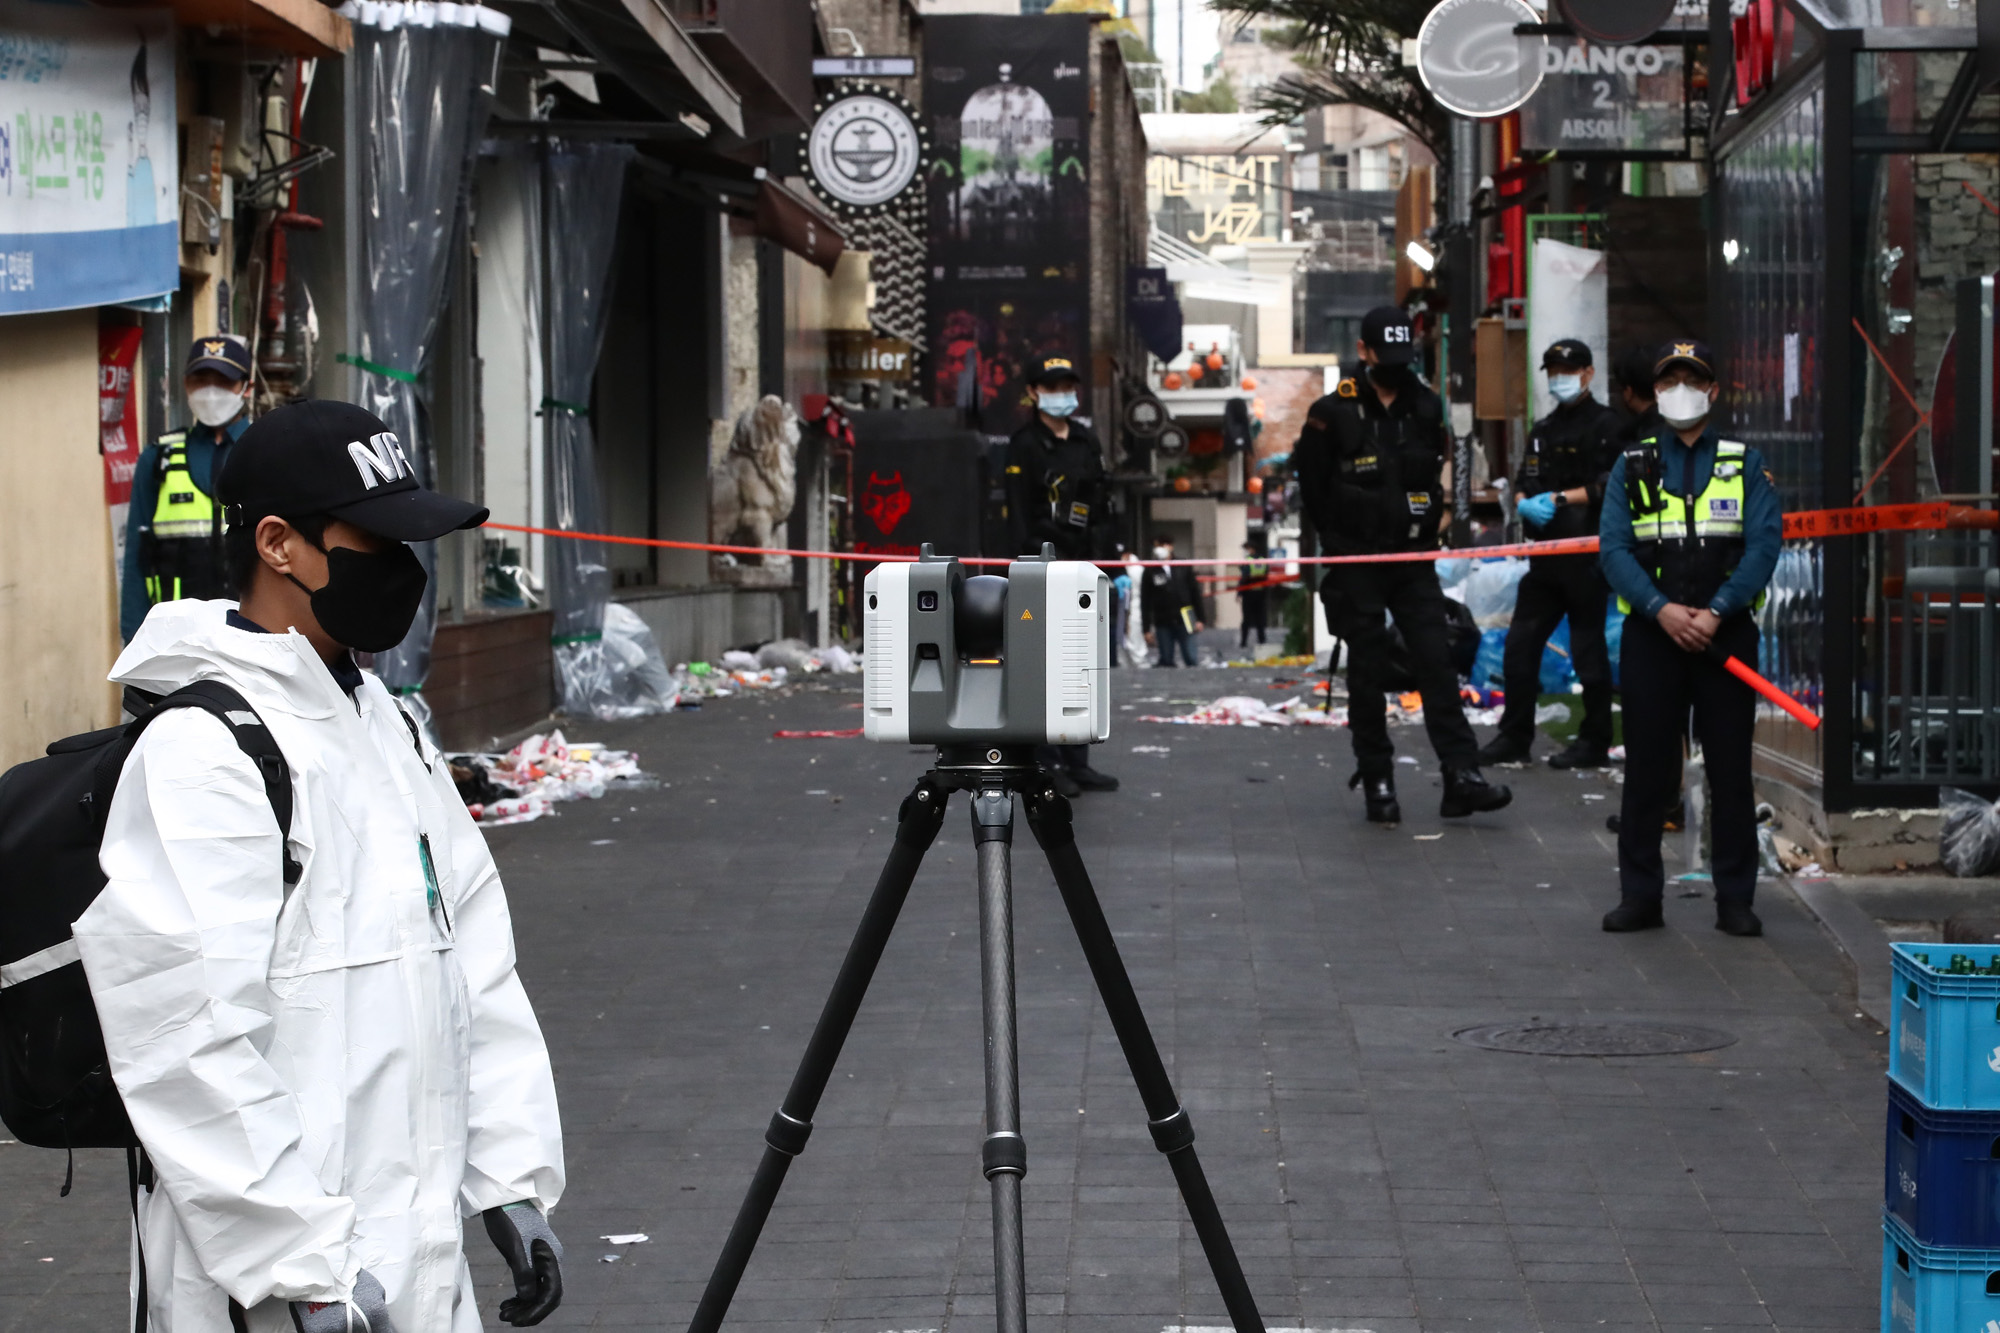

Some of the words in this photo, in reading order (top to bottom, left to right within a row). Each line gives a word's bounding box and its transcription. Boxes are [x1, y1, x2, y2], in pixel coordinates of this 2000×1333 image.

[1538, 45, 1663, 75] DANCO
[1592, 80, 1615, 109] 2
[1384, 326, 1410, 343] CSI
[830, 347, 908, 371] telier
